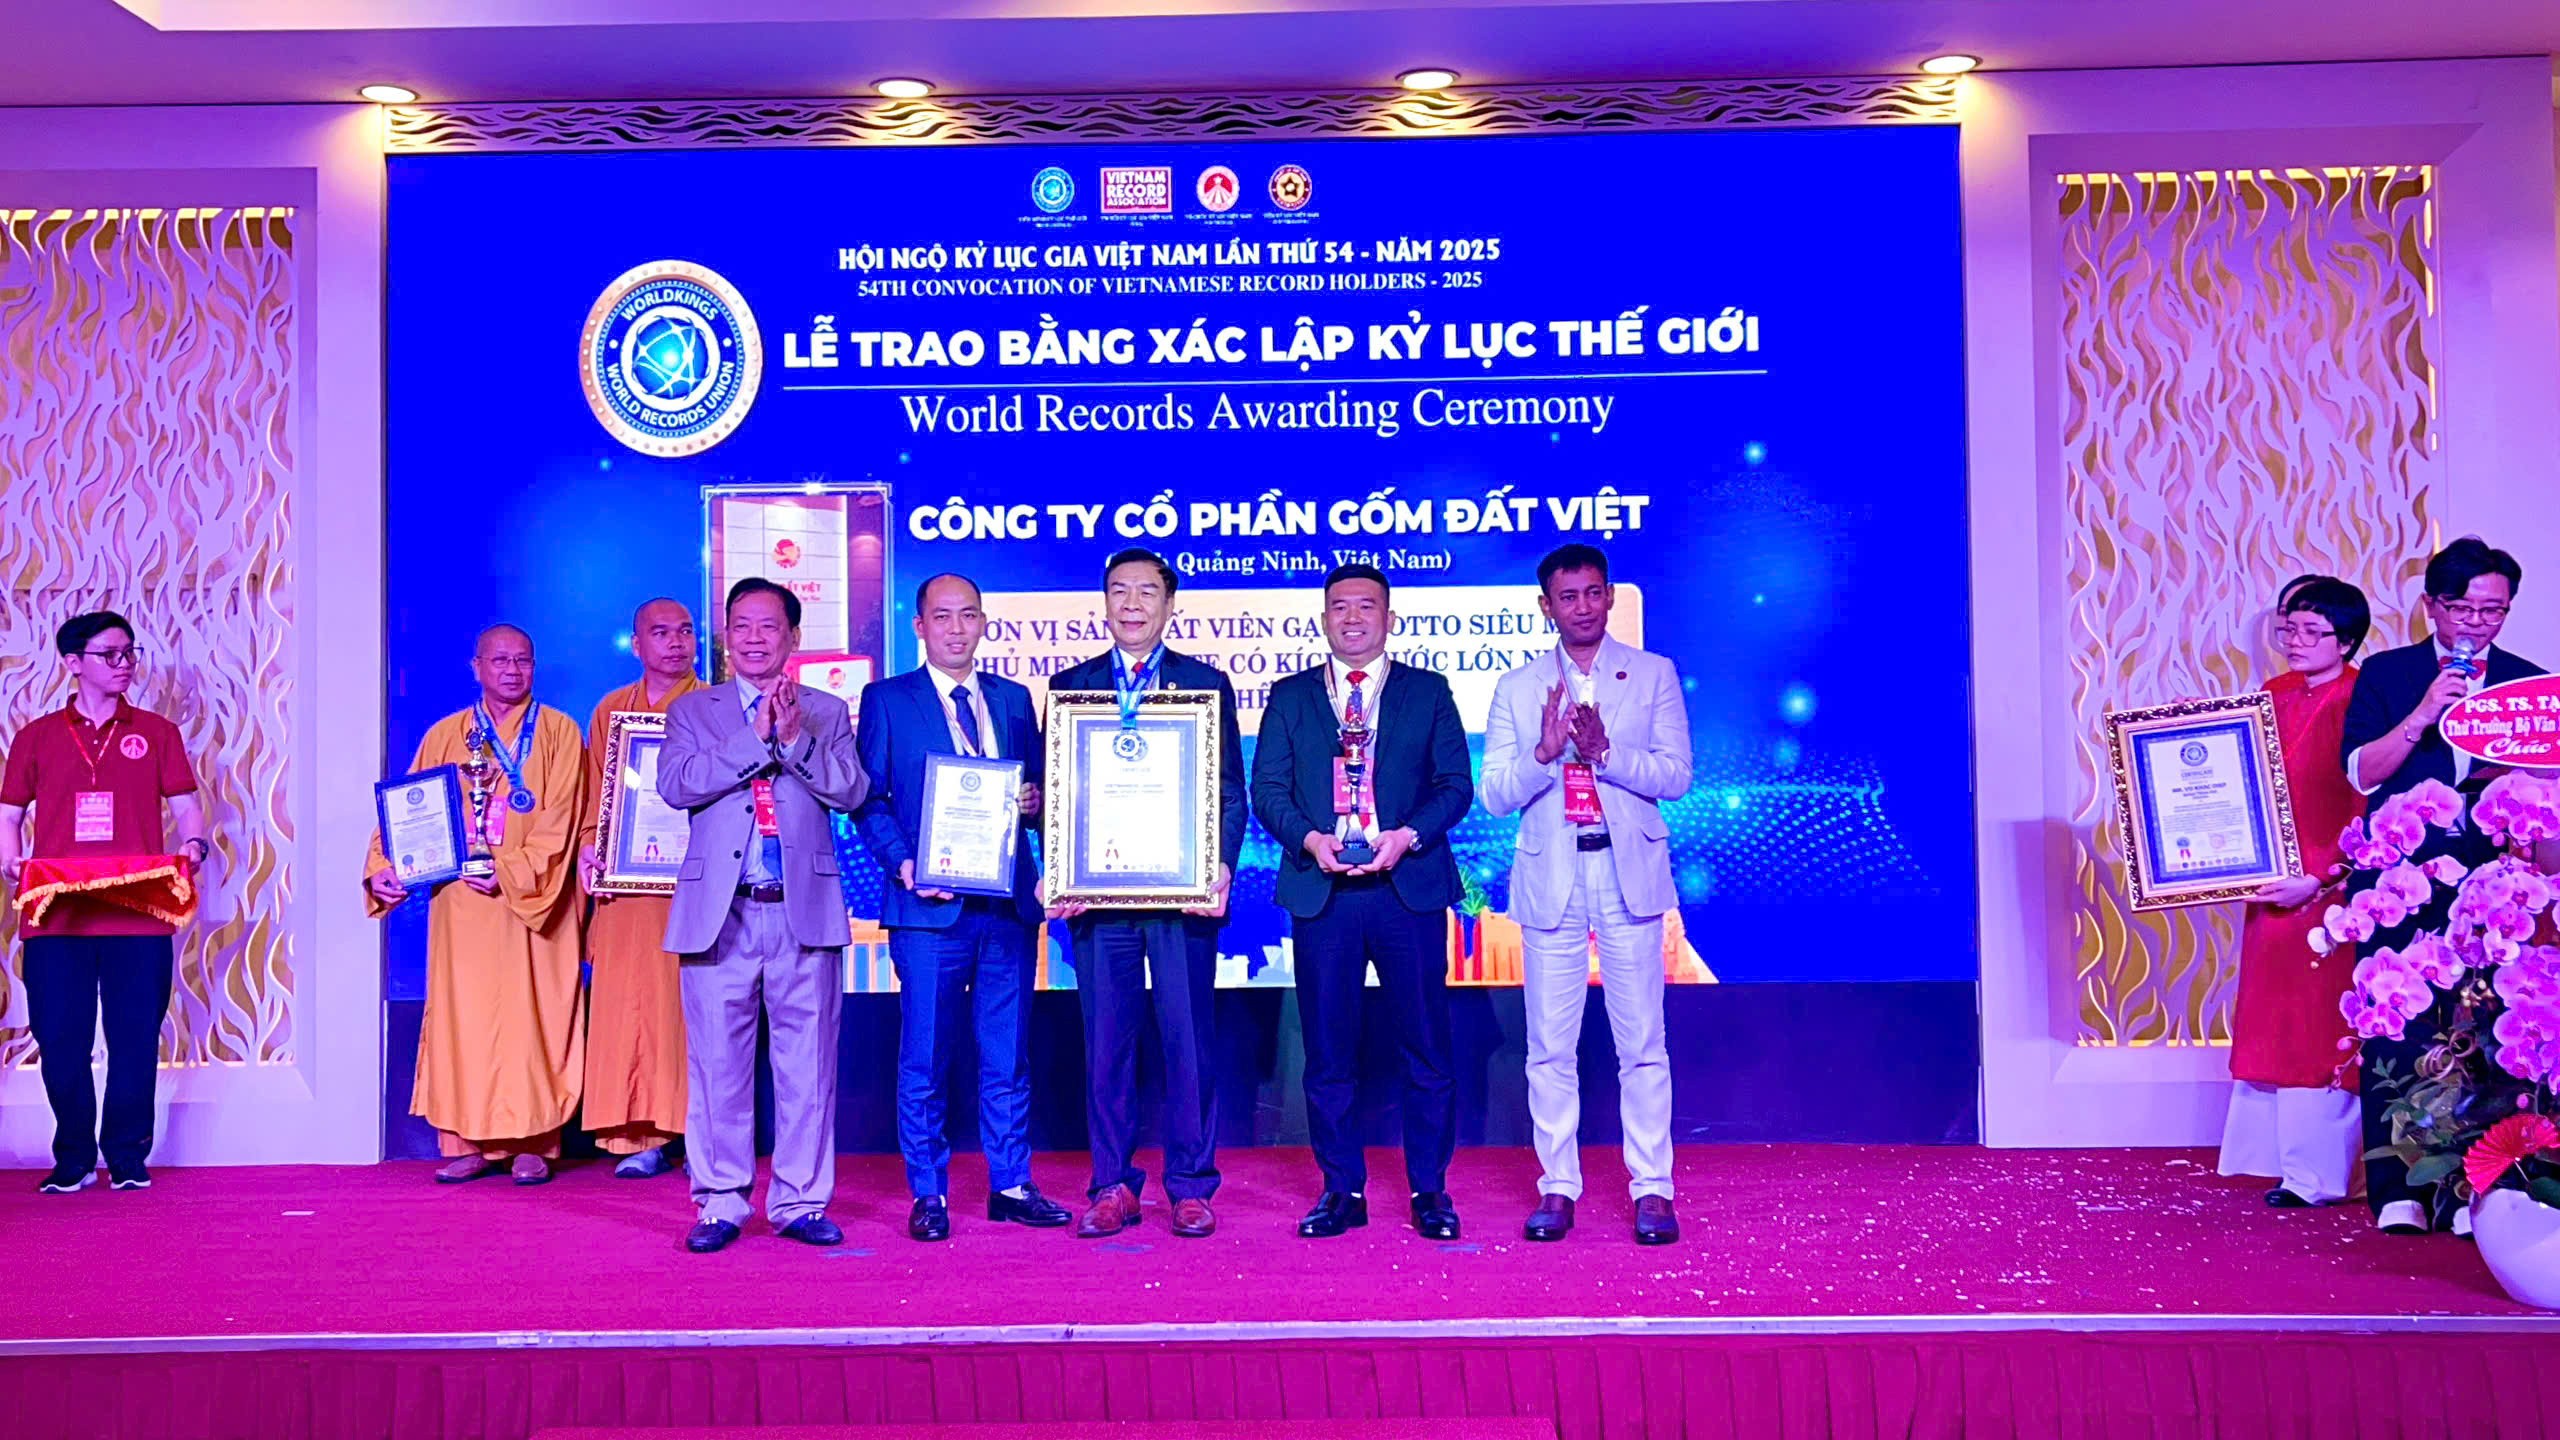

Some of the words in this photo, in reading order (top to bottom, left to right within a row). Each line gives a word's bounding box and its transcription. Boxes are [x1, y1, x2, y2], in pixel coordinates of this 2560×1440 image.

[1105, 170, 1167, 183] VIETNAM
[1106, 184, 1167, 197] RECORD
[1106, 197, 1167, 206] ASSOCIATION
[839, 244, 883, 273] HỘI
[891, 243, 947, 272] NGỘ
[955, 240, 987, 268] KỶ
[994, 246, 1037, 271] LỤC
[1044, 246, 1087, 267] GIA
[1094, 241, 1145, 270] VIỆT
[1152, 244, 1207, 265] NAM
[1267, 238, 1318, 263] THỨ
[1325, 242, 1354, 263] 54
[1377, 237, 1432, 262] NĂM
[1440, 239, 1500, 260] 2025
[859, 280, 906, 296] 54TH
[912, 278, 1062, 296] CONVOCATION
[1069, 278, 1096, 293] OF
[1102, 276, 1233, 293] VIETNAMESE
[1240, 275, 1324, 291] RECORD
[1330, 272, 1425, 290] HOLDERS
[1443, 272, 1482, 288] 2025
[620, 289, 719, 321] WORLDKINGS
[784, 315, 838, 367] LỄ
[851, 330, 984, 366] TRAO
[999, 314, 1134, 365] BẰNG
[1149, 318, 1246, 363] XÁC
[1262, 316, 1354, 371] LẬP
[1369, 310, 1431, 360] KỶ
[1444, 322, 1536, 368] LỤC
[1549, 306, 1649, 356] THẾ
[1658, 307, 1759, 354] GIỚI
[607, 362, 641, 415] WORLD
[640, 406, 707, 428] RECORDS
[704, 361, 735, 409] UNION
[900, 395, 1023, 432] World
[1037, 393, 1193, 431] Records
[1208, 390, 1399, 437] Awarding
[1413, 389, 1614, 433] Ceremony
[909, 497, 1037, 540] CÔNG
[1047, 505, 1104, 538] TY
[1114, 489, 1178, 538] CỔ
[1191, 489, 1316, 536] PHẦN
[1329, 487, 1432, 534] GỐM
[1444, 485, 1538, 532] ĐẤT
[1547, 486, 1649, 539] VIỆT
[1177, 551, 1255, 576] Quảng
[1263, 551, 1327, 573] Ninh,
[1389, 549, 1451, 569] Nam)
[984, 618, 1022, 641] ƠN
[1030, 620, 1058, 646] VỊ
[1207, 611, 1274, 638] VIÊN
[1390, 615, 1461, 636] OTTO
[1470, 608, 1534, 635] SIÊU
[1230, 647, 1266, 673] CÓ
[1275, 647, 1332, 673] KÍC
[1457, 643, 1513, 671] LỚN
[2464, 698, 2503, 713] PGS.
[2506, 696, 2533, 711] TS.
[2483, 738, 2552, 757] Chúc
